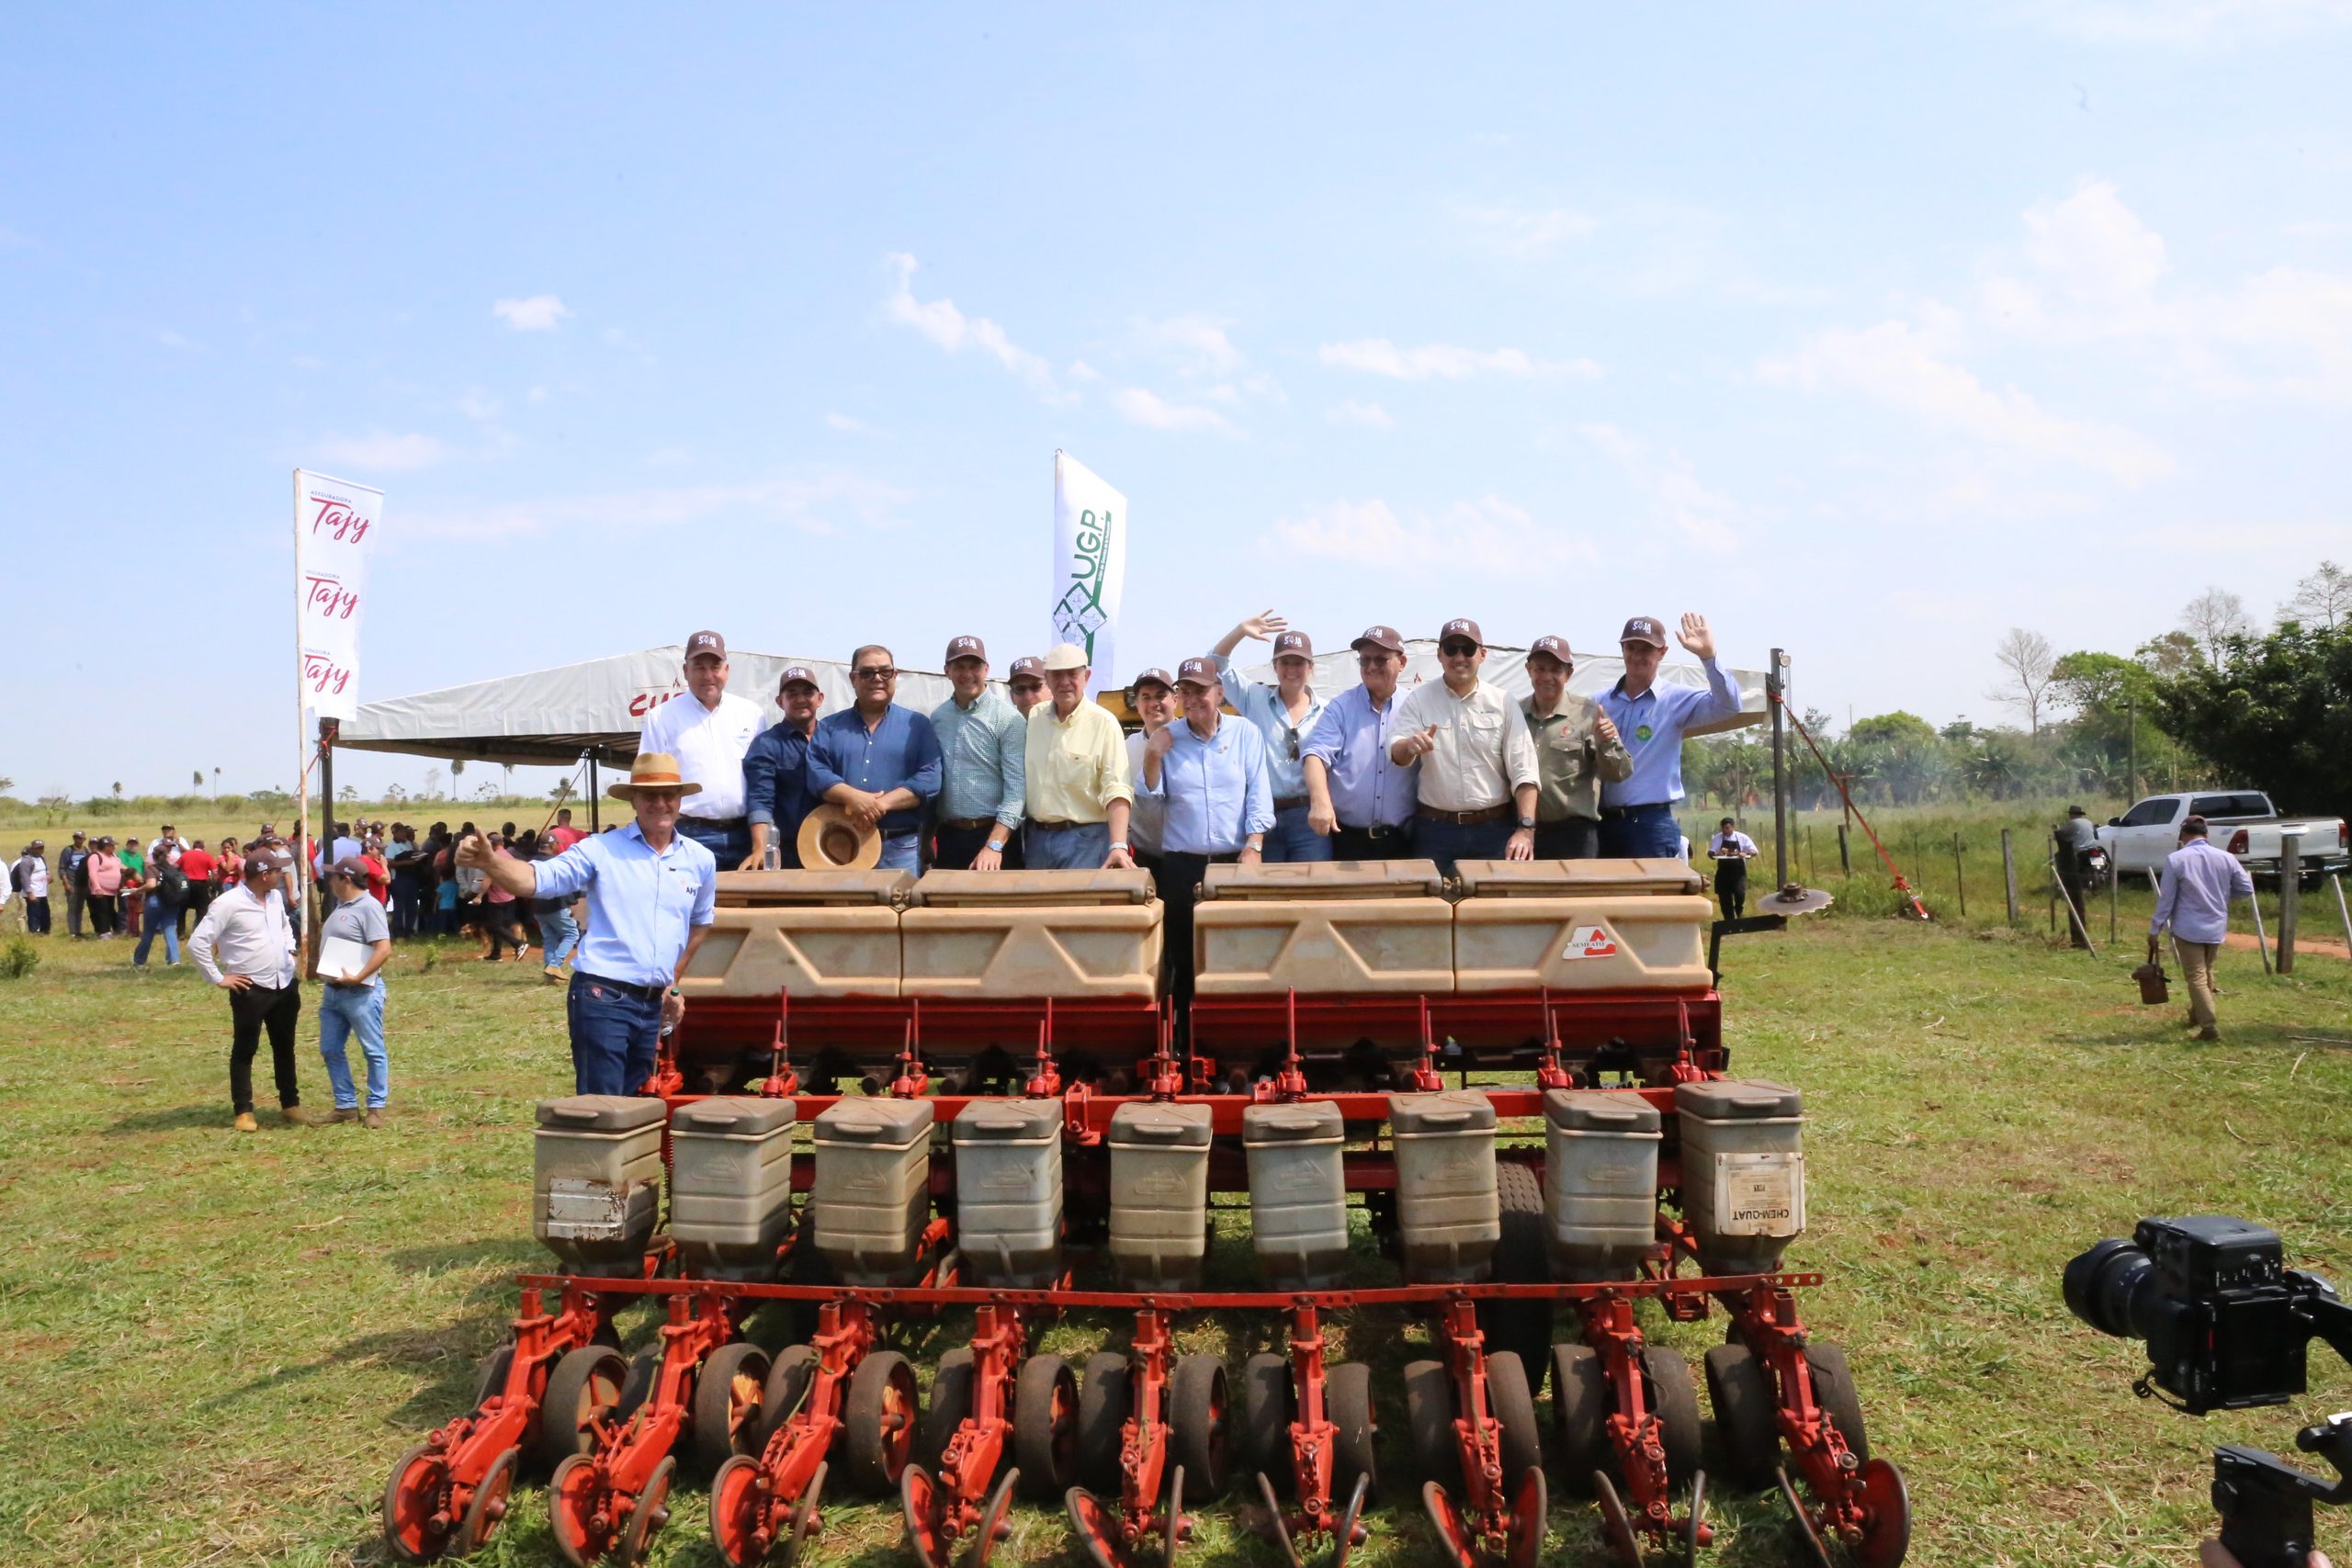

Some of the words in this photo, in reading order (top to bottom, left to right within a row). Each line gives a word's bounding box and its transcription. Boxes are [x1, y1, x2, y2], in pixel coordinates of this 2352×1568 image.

[311, 496, 370, 544] Tajy
[305, 575, 359, 619] Tajy
[304, 654, 352, 695] Tajy
[1733, 1209, 1790, 1221] CHEM-QUAT
